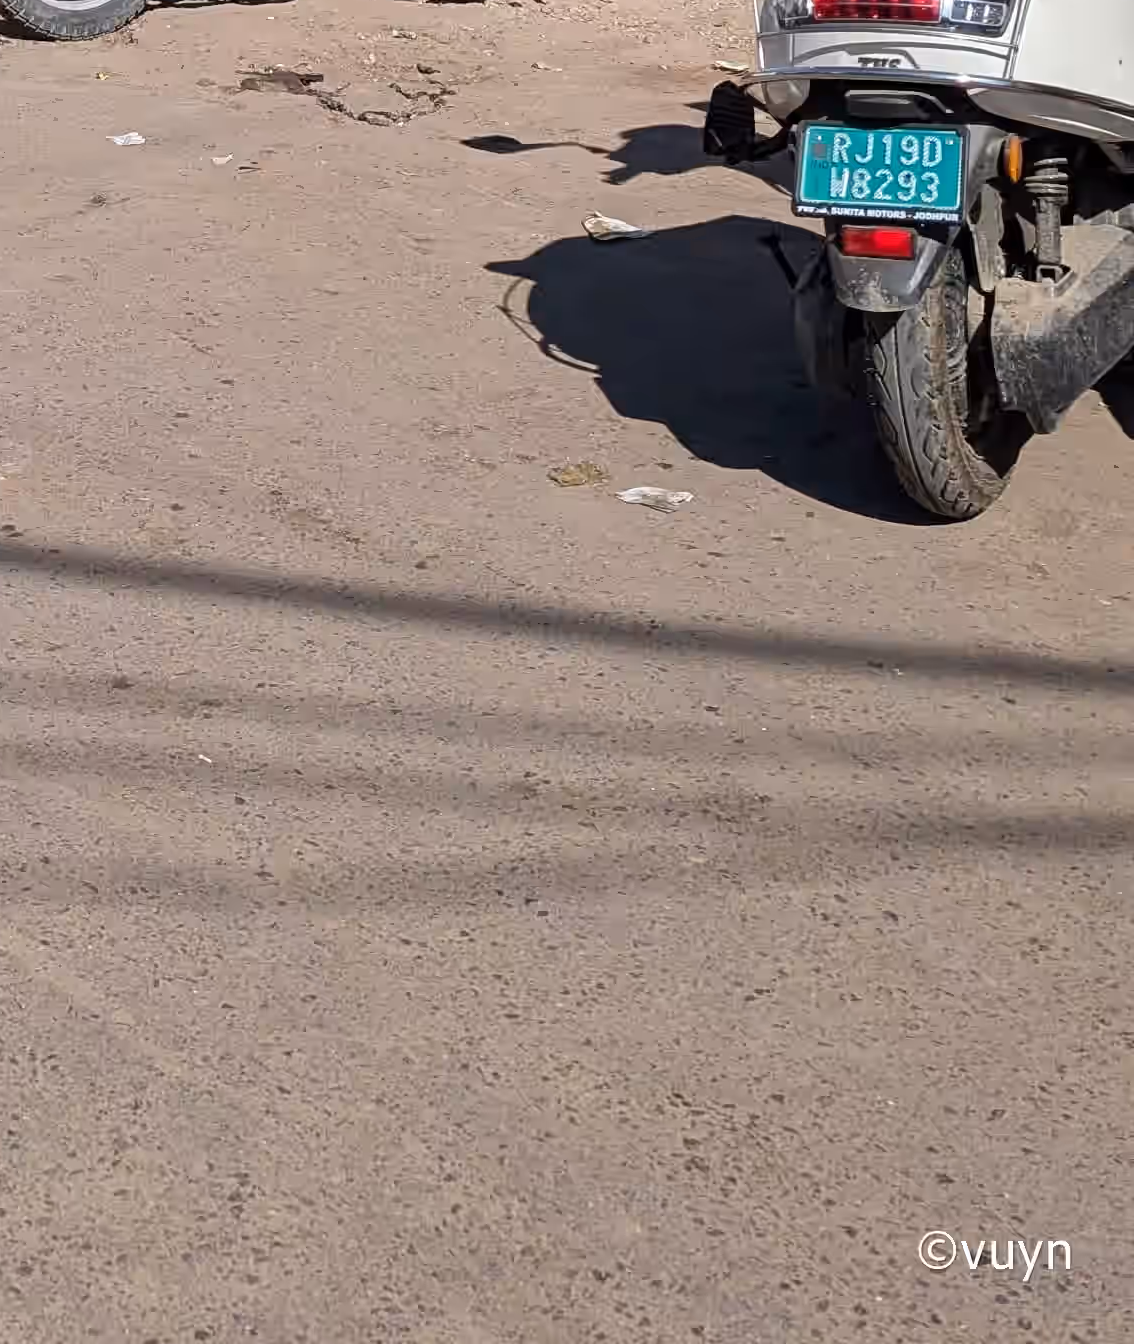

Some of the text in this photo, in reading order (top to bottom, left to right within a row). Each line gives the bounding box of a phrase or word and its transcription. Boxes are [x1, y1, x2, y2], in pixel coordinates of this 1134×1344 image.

[832, 132, 943, 168] RJ19D
[829, 166, 941, 204] W8293
[866, 208, 907, 220] MOTORS
